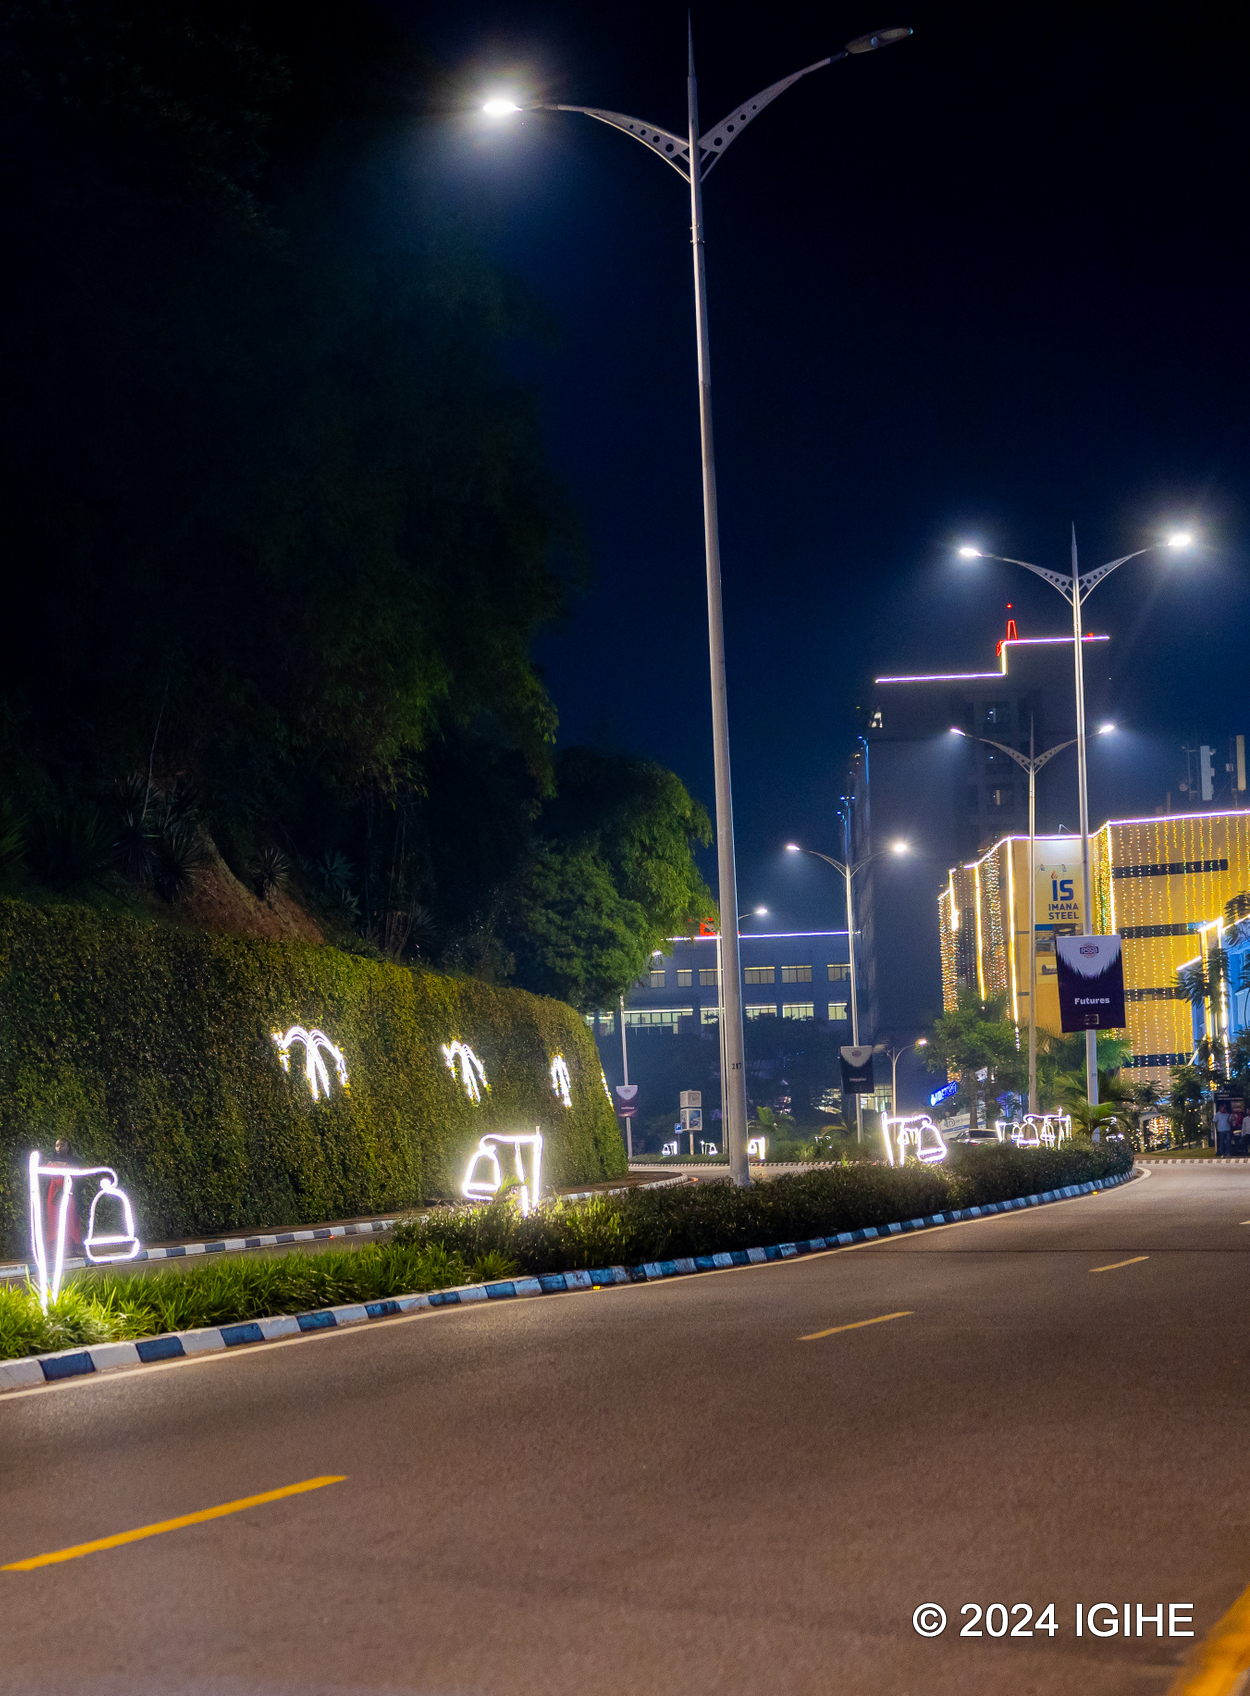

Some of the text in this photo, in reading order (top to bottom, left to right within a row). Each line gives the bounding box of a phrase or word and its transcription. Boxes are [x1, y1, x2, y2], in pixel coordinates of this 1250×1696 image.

[1052, 879, 1074, 901] IS
[1048, 903, 1079, 911] IMANA
[1048, 911, 1079, 920] STEEL
[1074, 997, 1110, 1005] Futures
